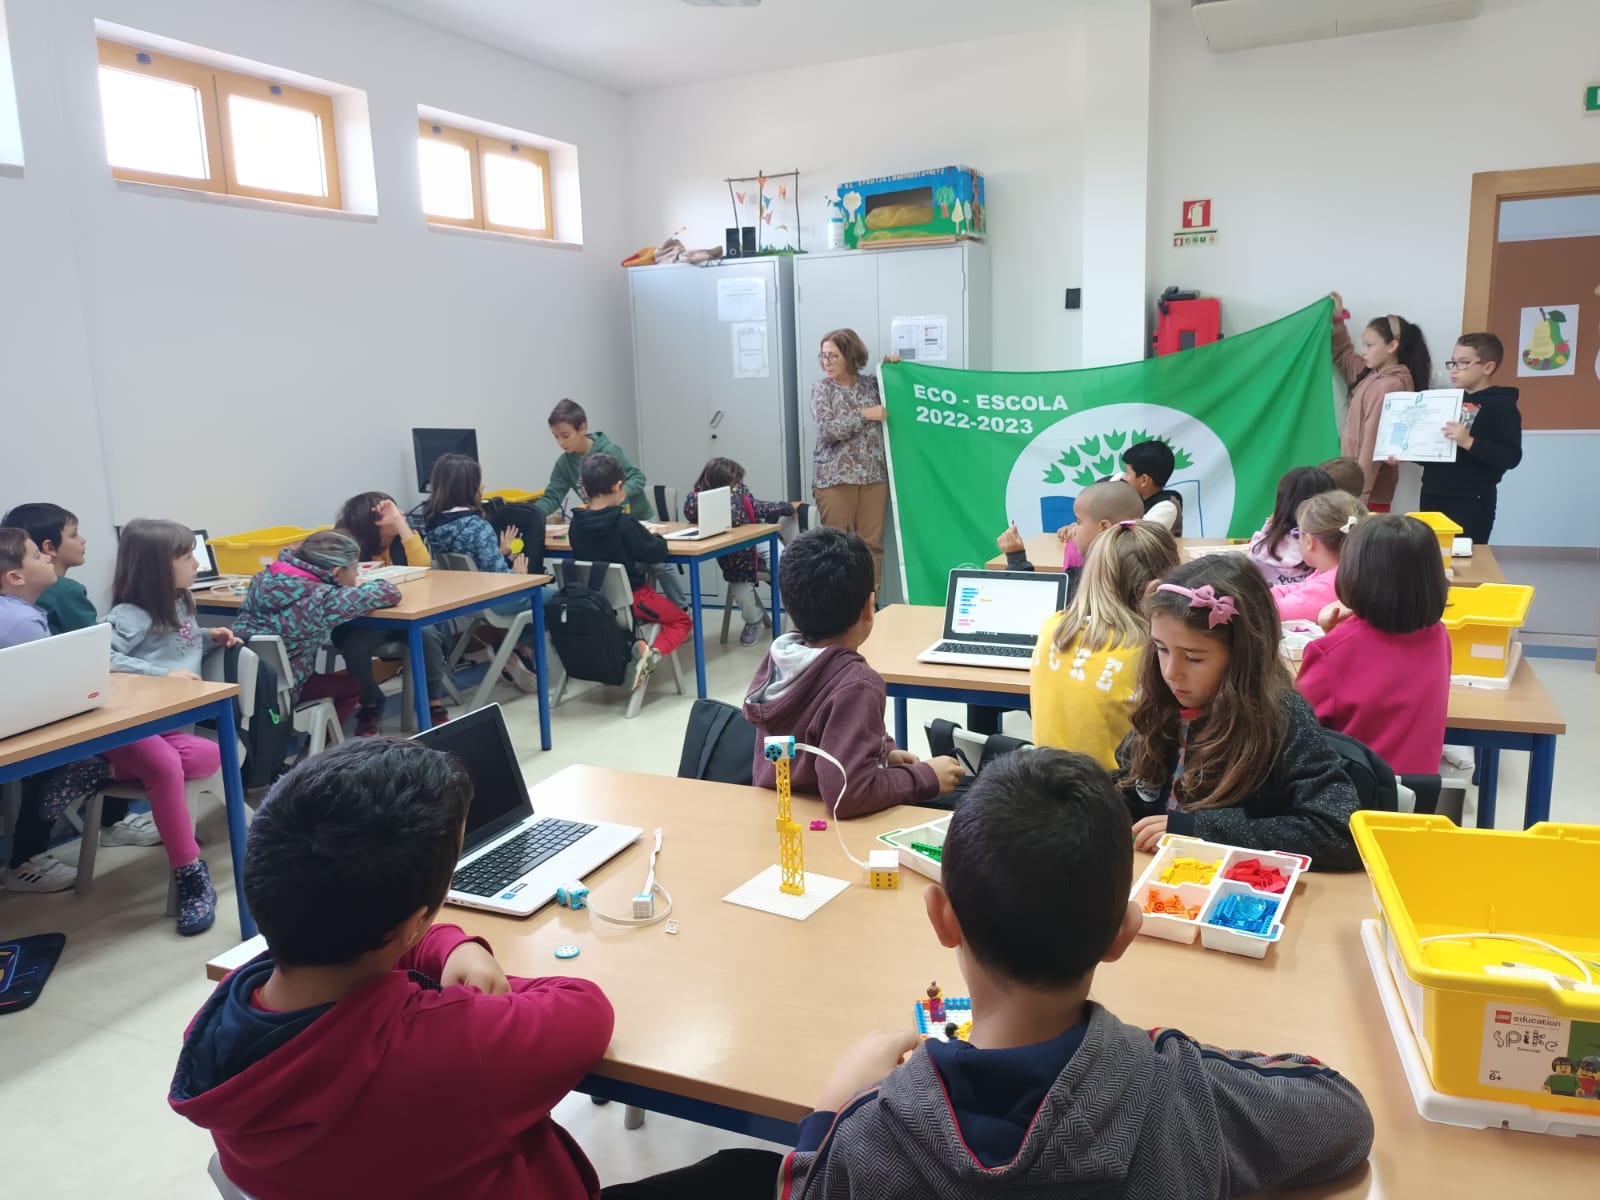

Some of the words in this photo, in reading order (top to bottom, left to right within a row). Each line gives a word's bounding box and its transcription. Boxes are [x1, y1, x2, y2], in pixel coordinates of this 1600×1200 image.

[913, 384, 957, 405] ECO
[976, 394, 1069, 411] ESCOLA
[915, 406, 1034, 434] 2022-2023
[1513, 1015, 1561, 1027] education
[1489, 1072, 1503, 1081] 6+
